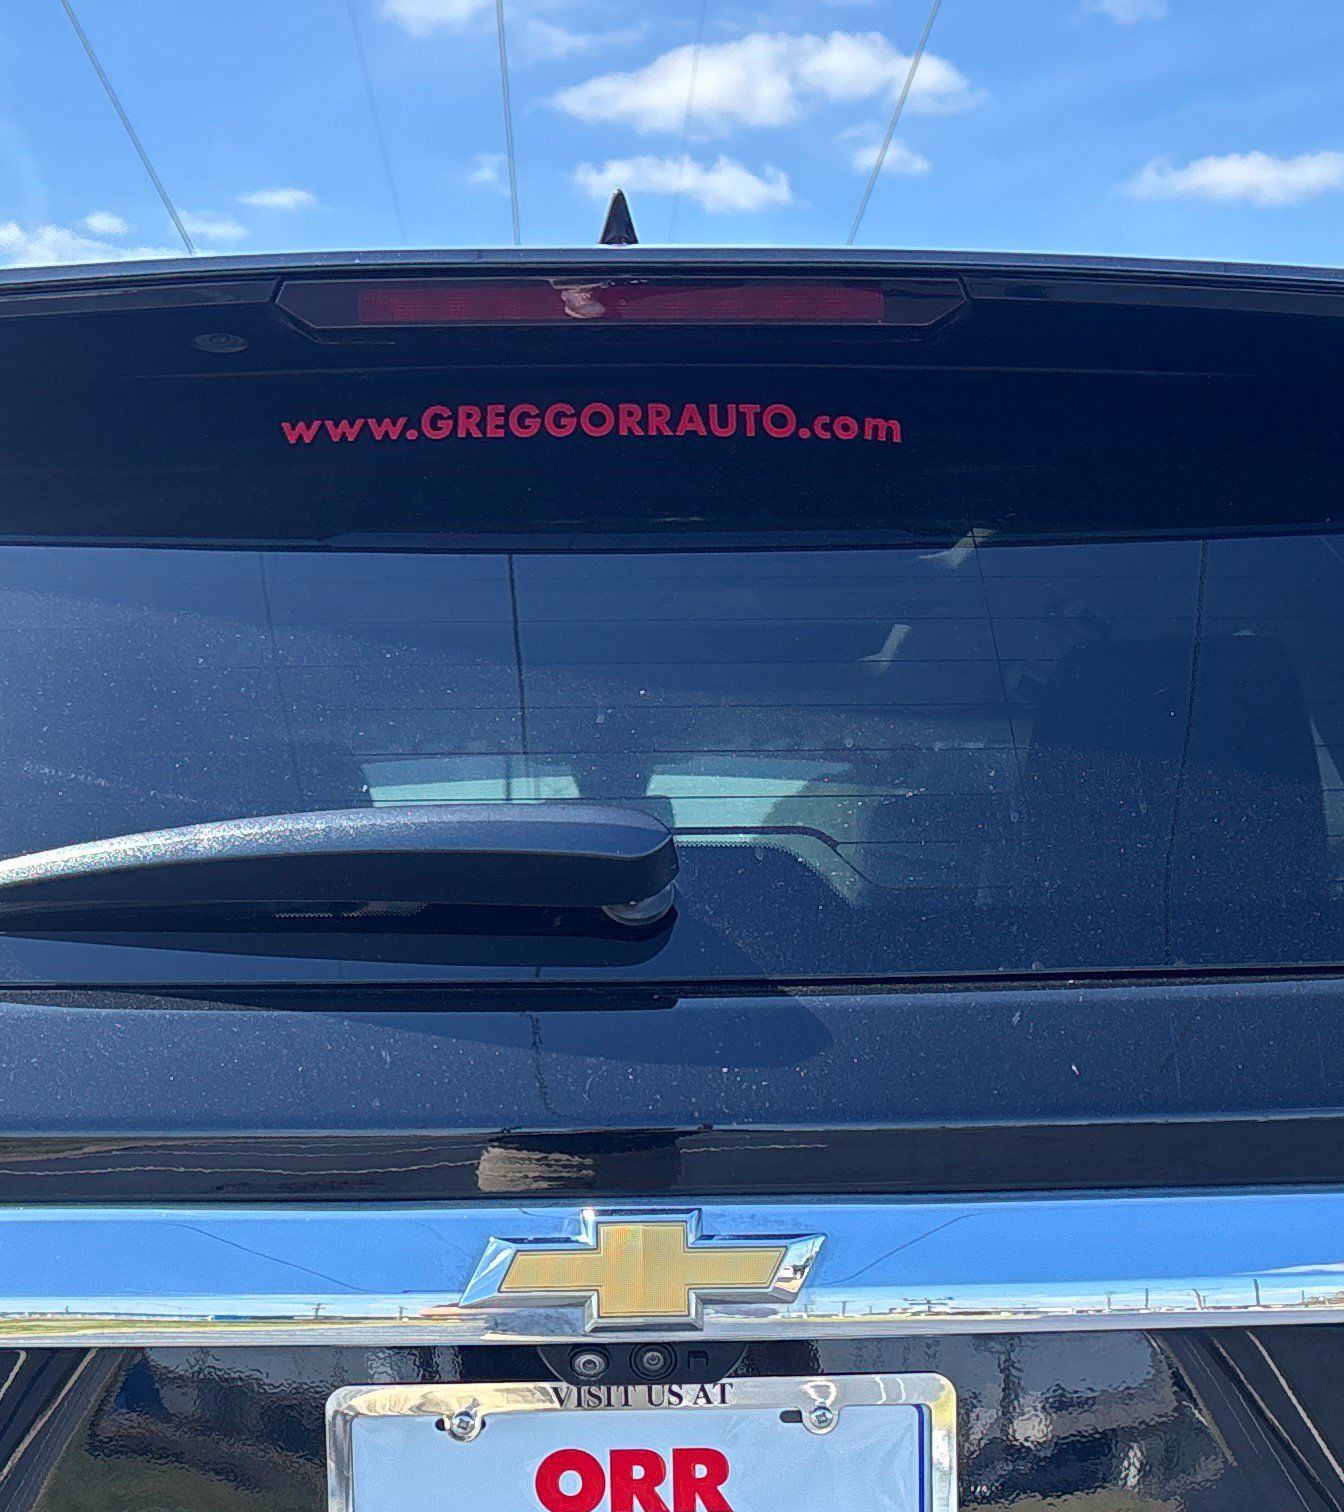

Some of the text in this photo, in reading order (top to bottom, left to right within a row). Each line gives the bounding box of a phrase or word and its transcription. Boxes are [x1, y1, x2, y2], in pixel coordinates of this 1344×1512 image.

[281, 402, 903, 443] www.GREGGORRAUTO.com
[550, 1382, 734, 1409] VISIT US AT
